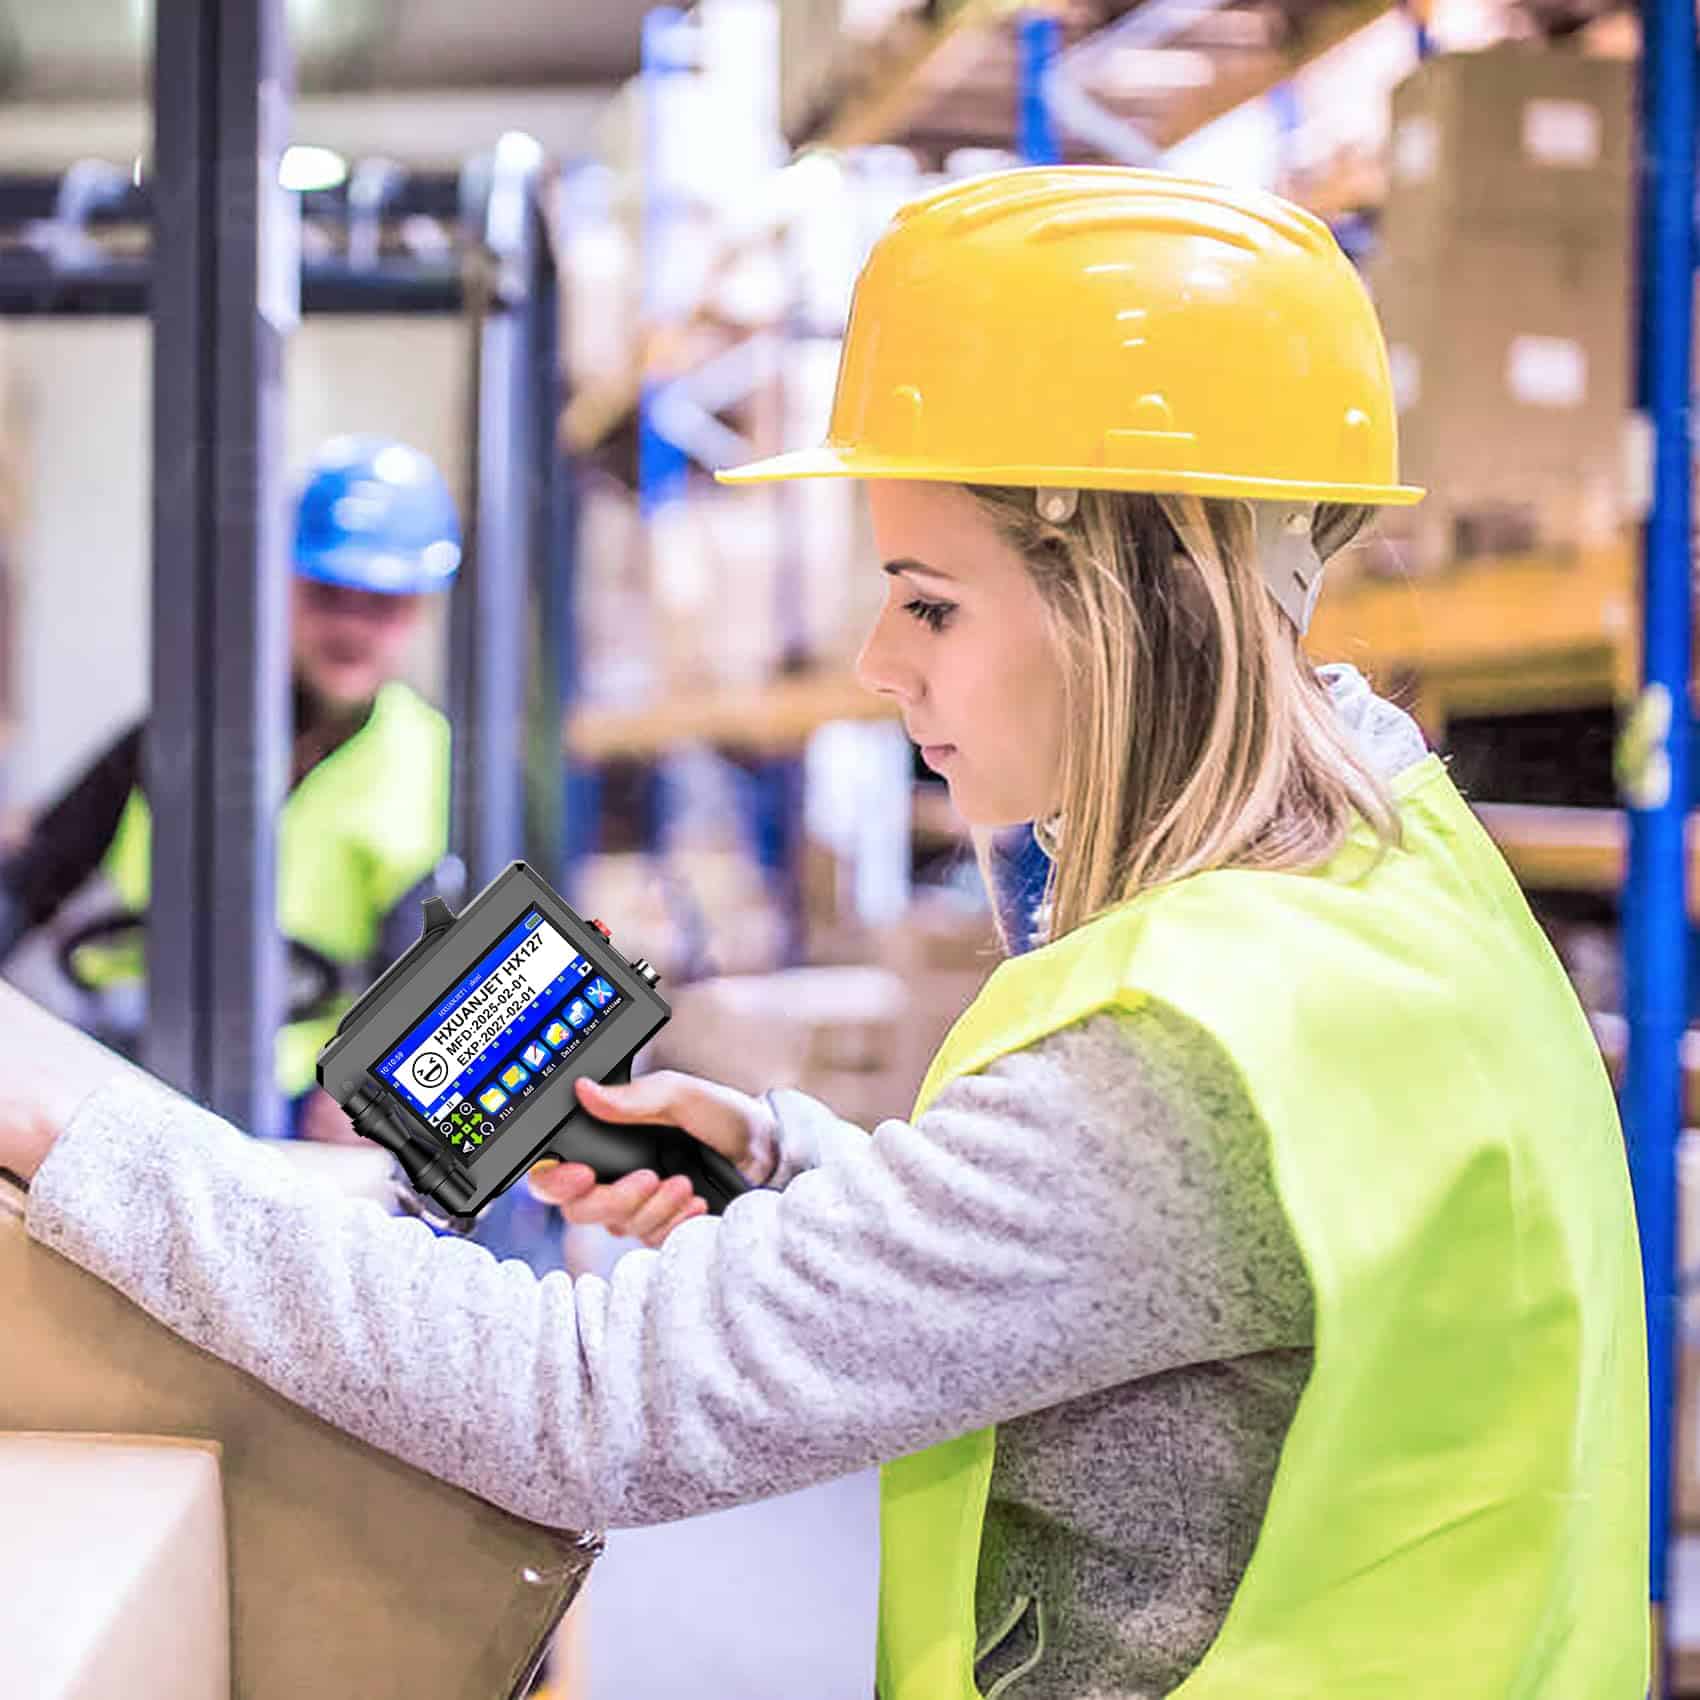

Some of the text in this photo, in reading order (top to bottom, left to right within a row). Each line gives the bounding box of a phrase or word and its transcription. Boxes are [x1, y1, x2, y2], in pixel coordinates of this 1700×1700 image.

[434, 932, 543, 1045] HXUANJET HX127
[446, 974, 527, 1056] MFD:2025-02-01
[457, 986, 536, 1066] EXP:2027-02-01
